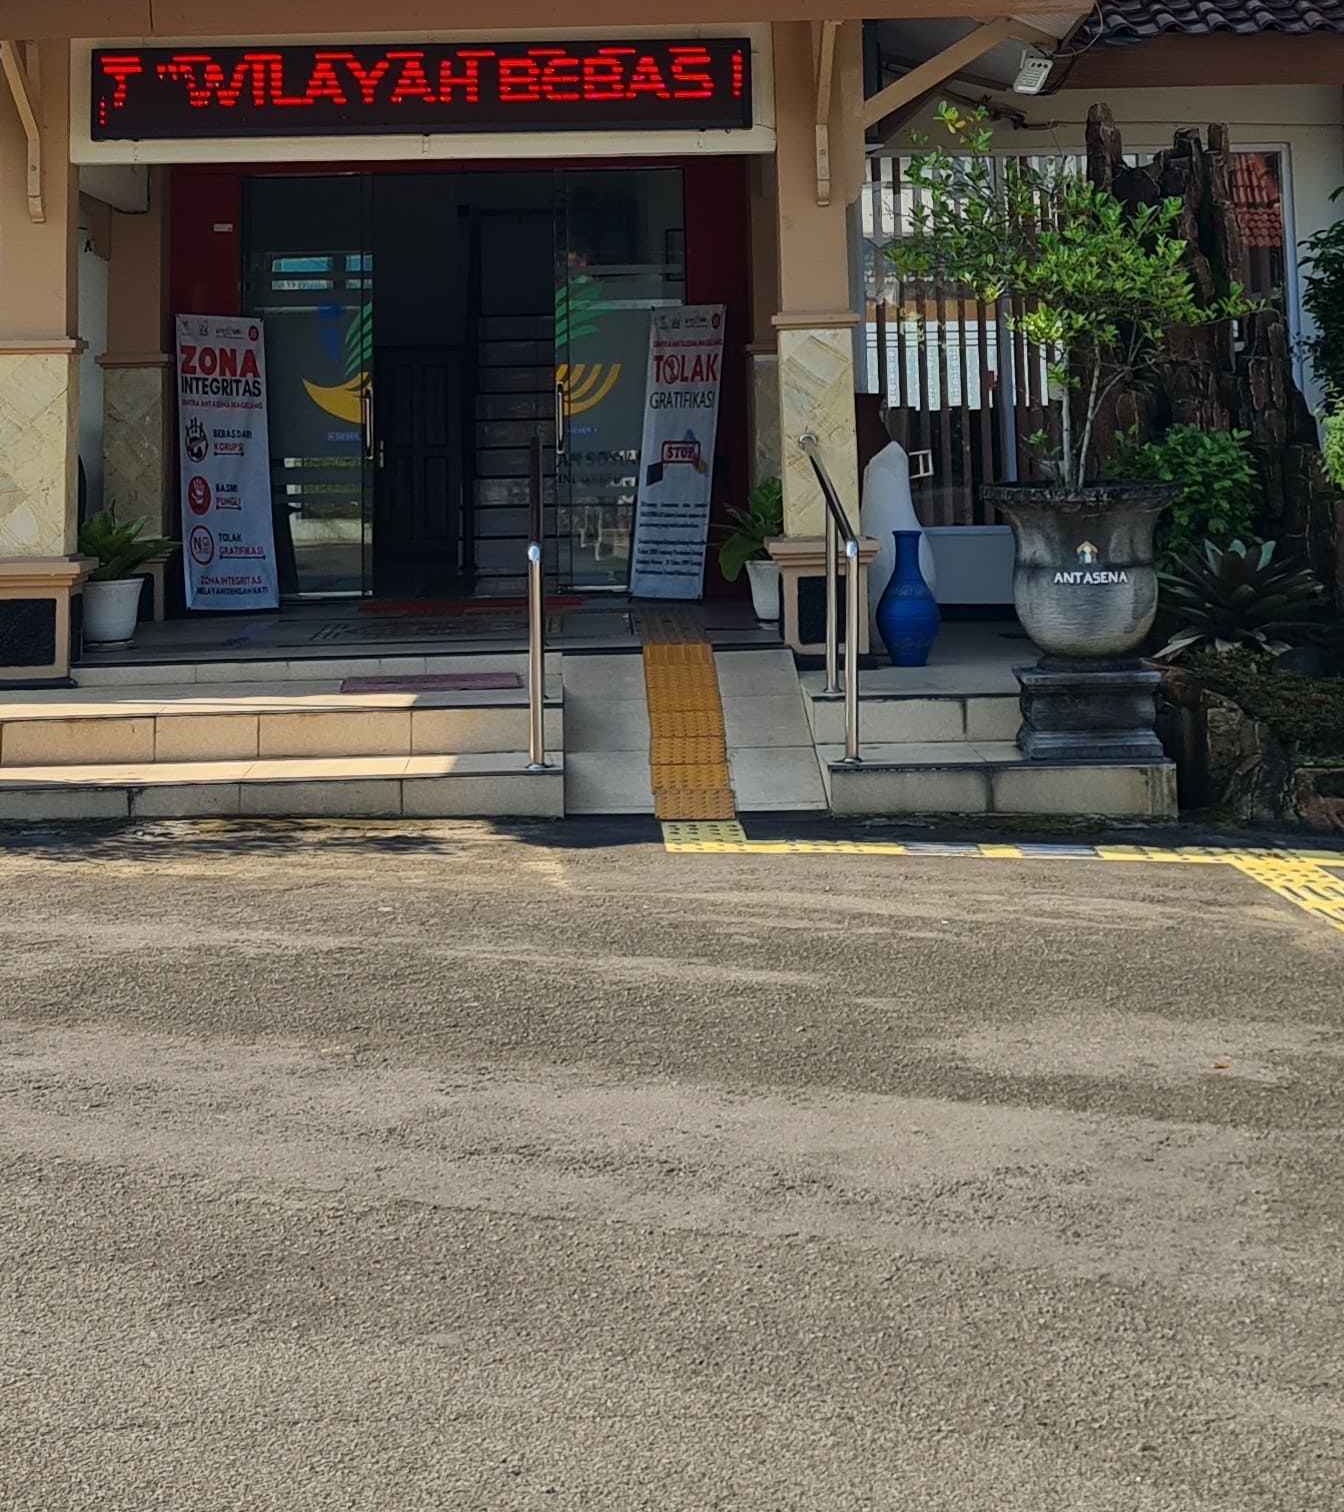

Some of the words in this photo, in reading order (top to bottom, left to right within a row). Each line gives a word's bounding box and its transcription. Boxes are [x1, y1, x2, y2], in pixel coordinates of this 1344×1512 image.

[499, 47, 714, 100] BEBAS
[181, 345, 260, 377] ZONA
[654, 353, 718, 384] TOLAK
[181, 376, 261, 398] INTEGRITAS
[649, 391, 715, 409] GRATIFIKASI
[667, 446, 694, 459] STOP
[219, 533, 242, 542] TOLAK
[1054, 571, 1128, 585] ANTASENA
